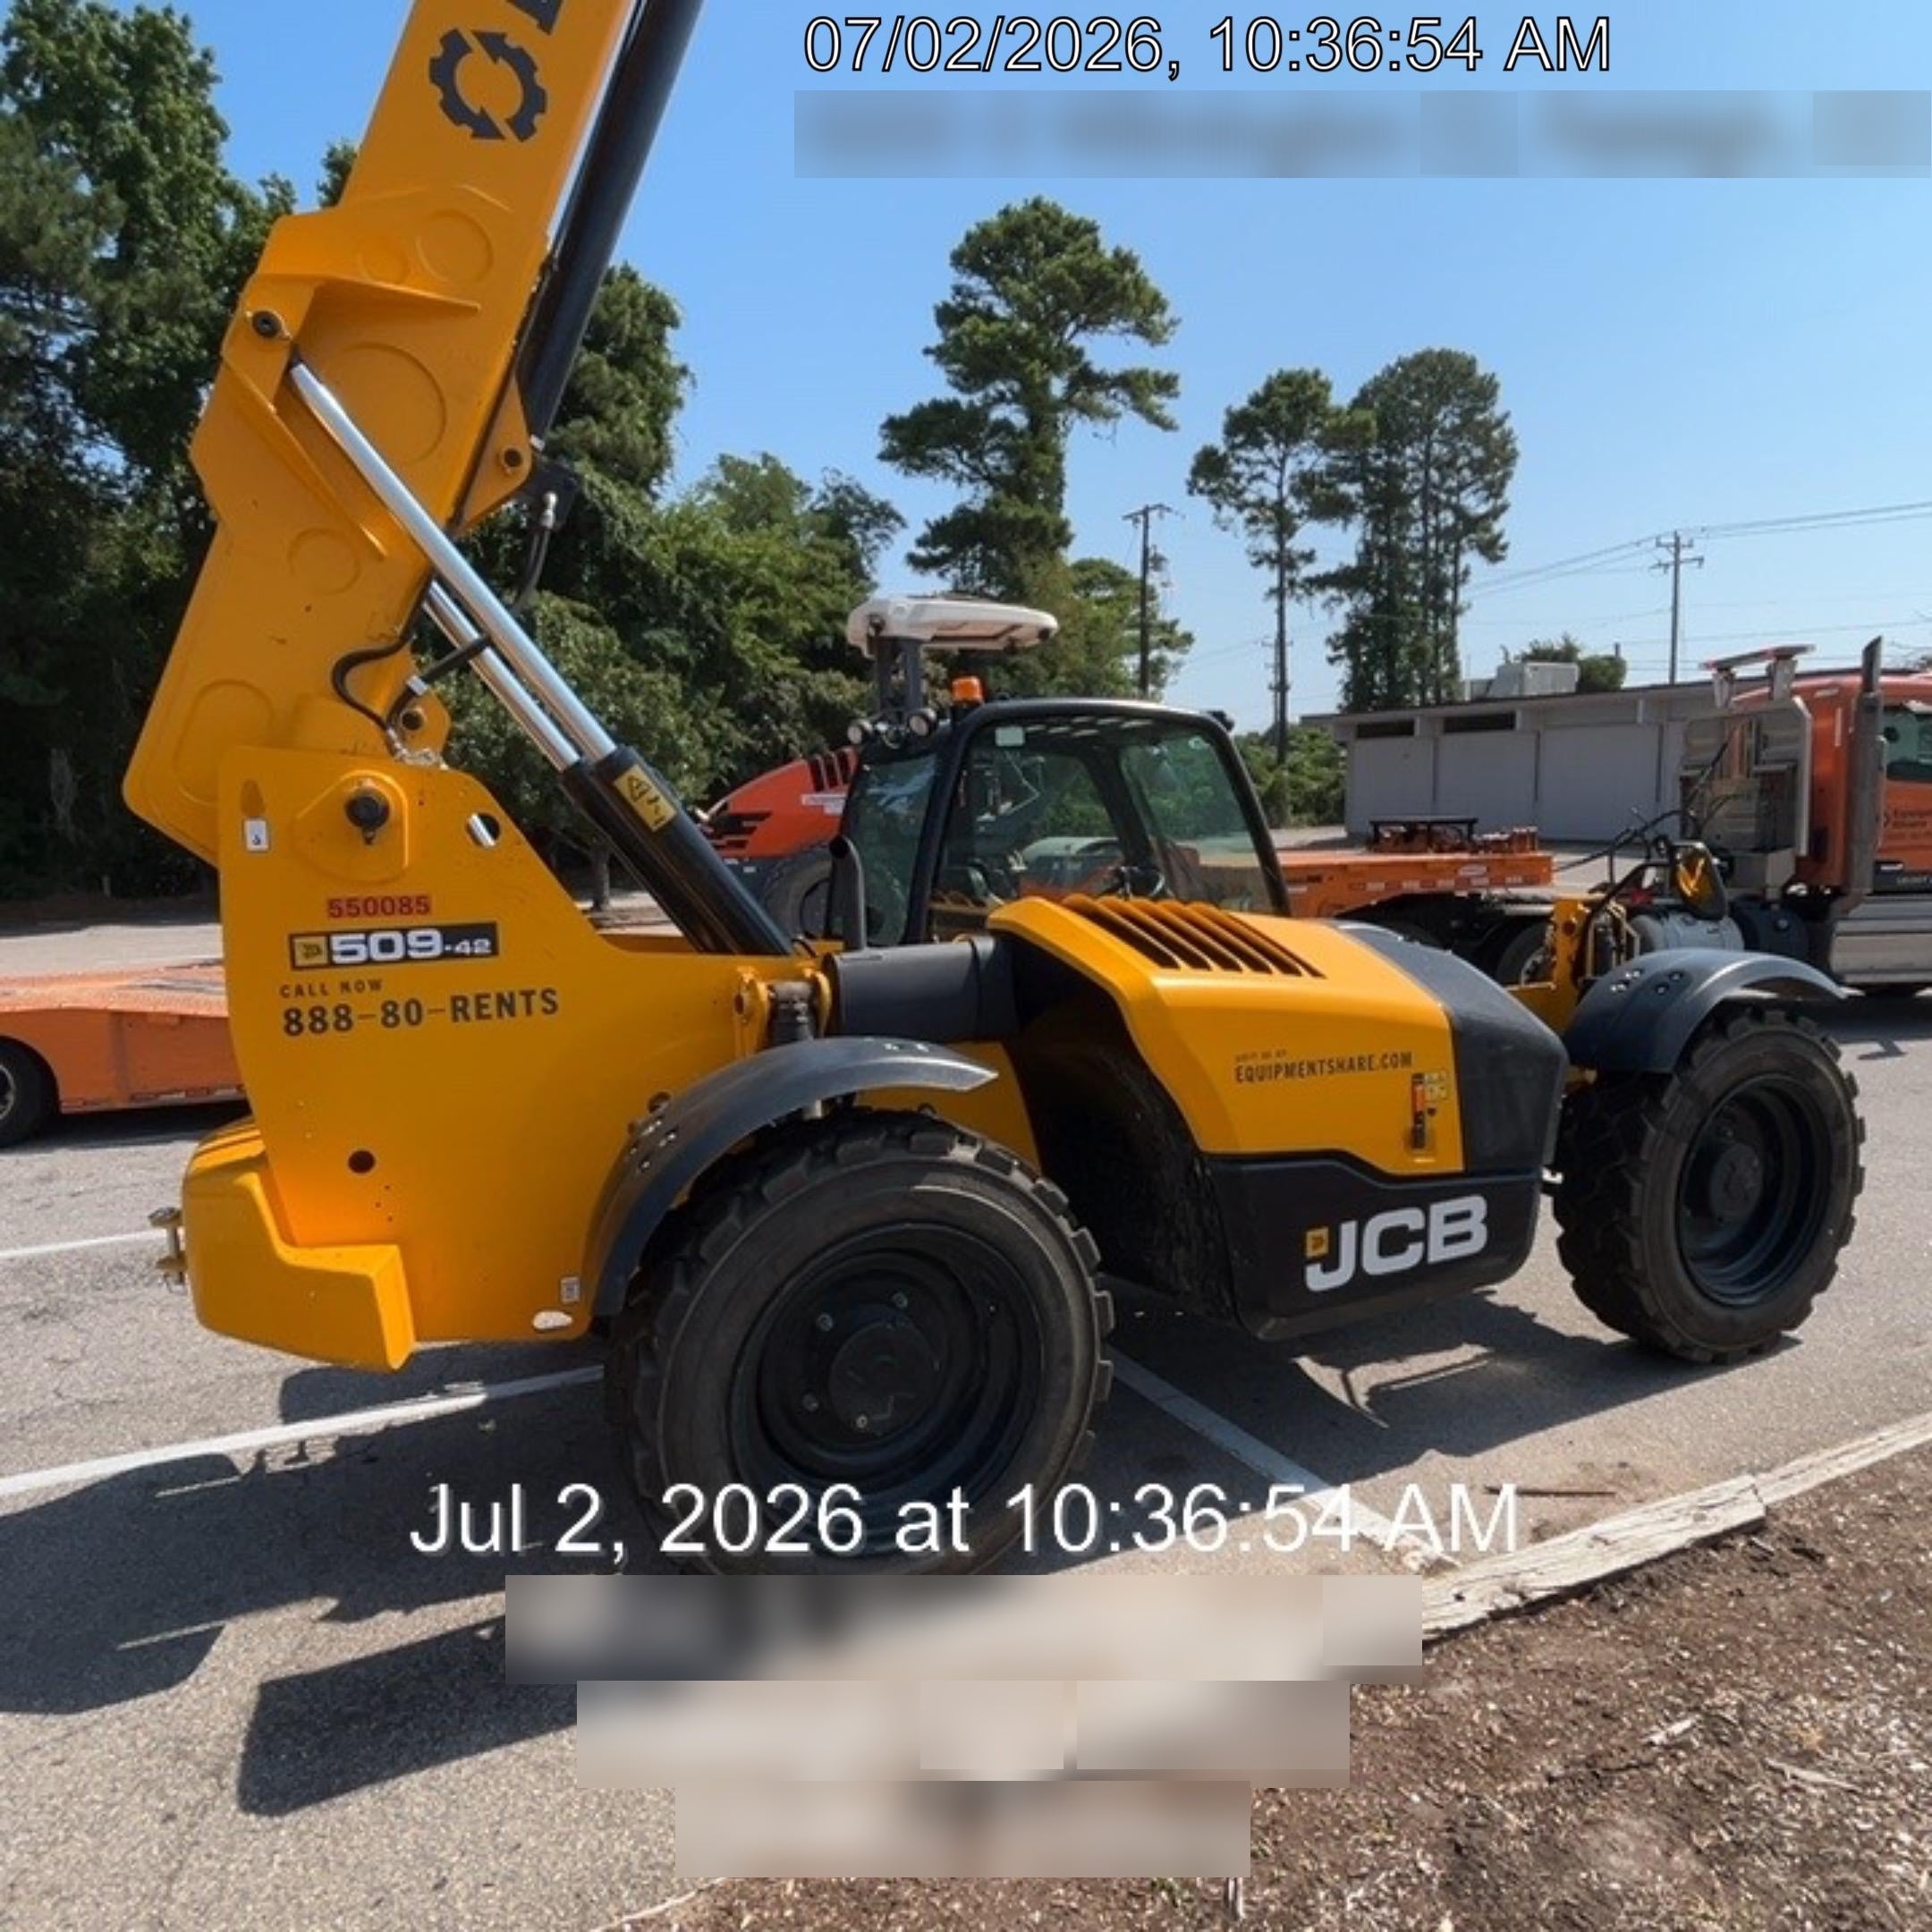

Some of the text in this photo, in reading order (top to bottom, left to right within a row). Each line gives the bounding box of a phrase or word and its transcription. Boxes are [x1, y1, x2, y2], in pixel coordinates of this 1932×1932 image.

[328, 895, 430, 918] 550085
[329, 928, 492, 965] 509-42
[279, 979, 383, 998] CALL NOW
[1234, 1051, 1412, 1083] EQUIPMENTSHARE.COM
[1304, 1194, 1488, 1292] JCB
